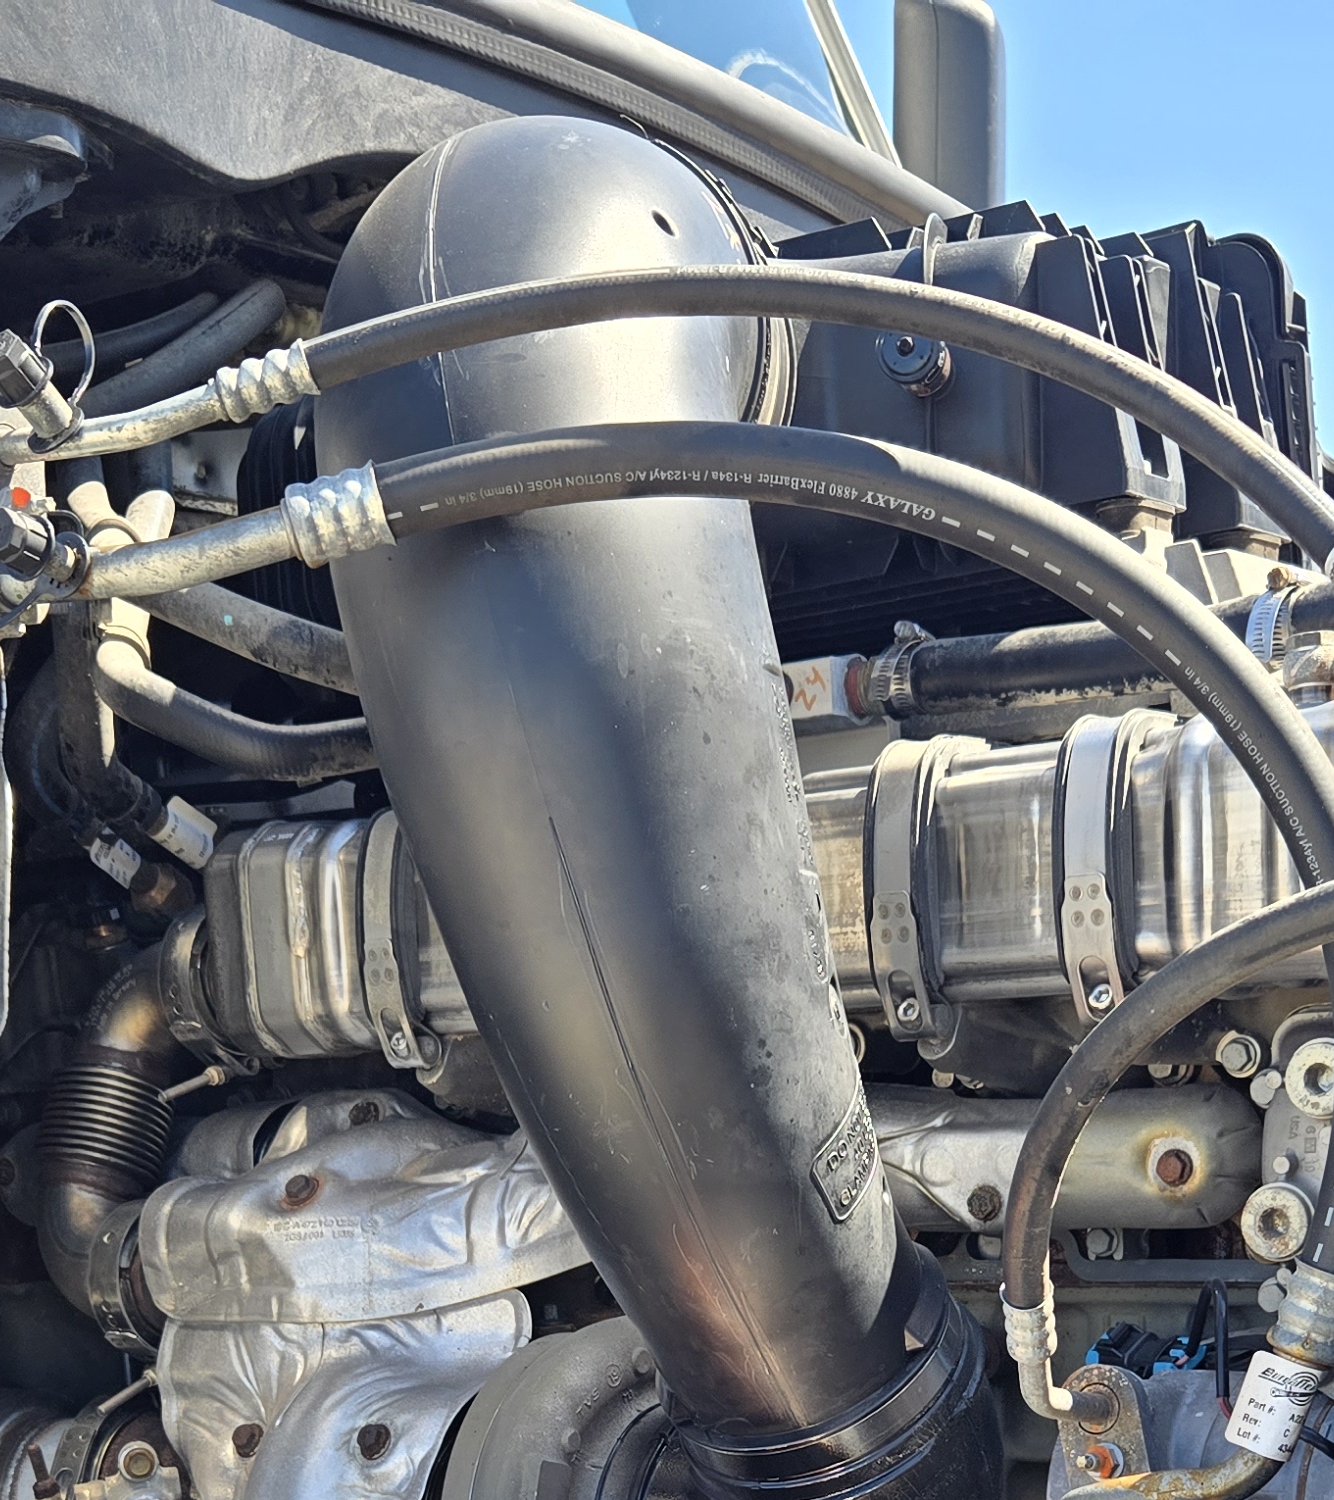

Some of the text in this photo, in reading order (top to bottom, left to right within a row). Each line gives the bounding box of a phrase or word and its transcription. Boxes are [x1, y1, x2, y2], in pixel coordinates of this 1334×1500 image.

[565, 472, 622, 487] SUCTION
[626, 471, 647, 483] A/C
[650, 470, 701, 482] R-1234yf
[711, 470, 752, 484] R-134a
[480, 483, 524, 500] (19mm)
[527, 478, 562, 492] HOSE
[757, 473, 825, 495] FlexBarrier
[829, 483, 858, 500] 4880
[445, 496, 458, 505] in
[458, 492, 477, 505] 3/4
[861, 491, 936, 521] GALAXY
[1193, 675, 1209, 695] 3/4
[1207, 692, 1244, 732] (19mm)
[1237, 731, 1264, 766] HOSE
[1259, 761, 1297, 815] SUCTION
[1290, 813, 1306, 838] A/C
[1247, 1397, 1267, 1412] Part
[1242, 1413, 1262, 1428] Rev:
[1236, 1427, 1252, 1440] Lot
[1283, 1428, 1291, 1438] C
